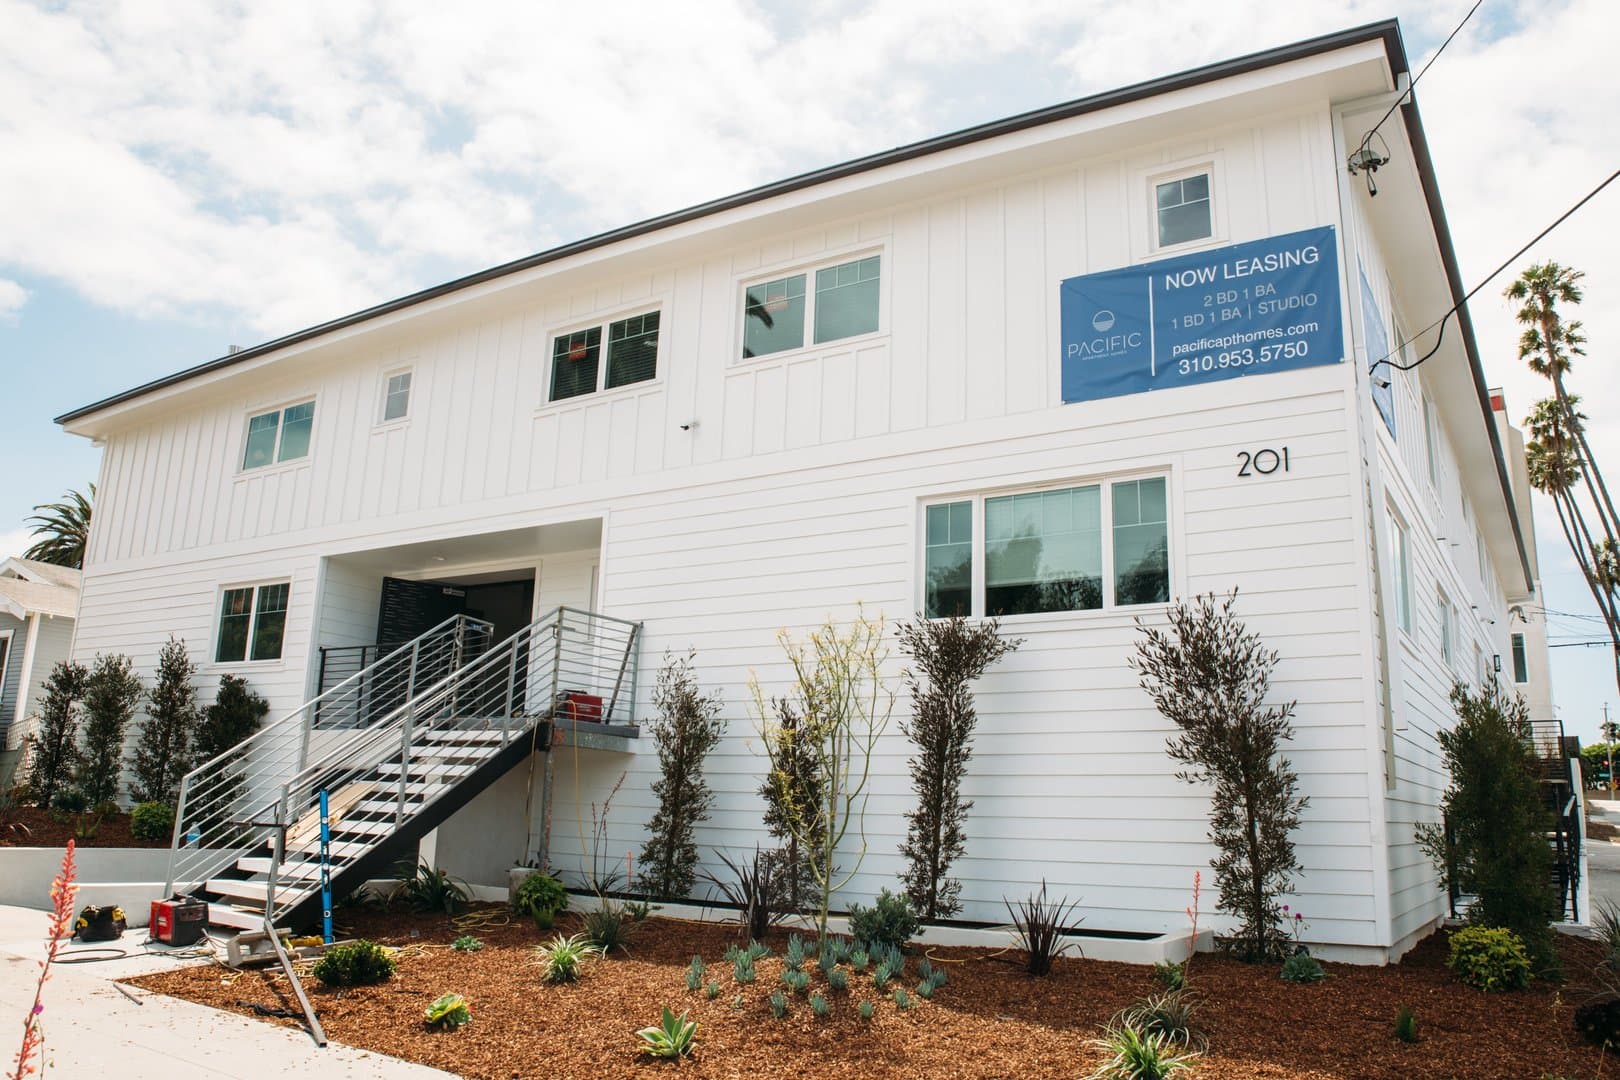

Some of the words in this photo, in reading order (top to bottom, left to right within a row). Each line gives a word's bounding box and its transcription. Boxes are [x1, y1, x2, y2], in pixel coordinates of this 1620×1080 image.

[1166, 265, 1217, 290] NOW
[1224, 246, 1319, 279] LEASING
[1171, 317, 1177, 329] 1
[1183, 313, 1205, 328] BD
[1209, 312, 1215, 323] 1
[1221, 307, 1242, 320] BA
[1258, 293, 1318, 315] STUDIO
[1203, 295, 1213, 307] 2
[1217, 290, 1238, 304] BD
[1243, 288, 1249, 300] 1
[1255, 283, 1276, 297] BA
[1068, 332, 1141, 358] PACIFIC
[1172, 322, 1319, 357] pacificapthomes.com
[1178, 340, 1308, 375] 310.953.5750
[1237, 446, 1289, 477] 201
